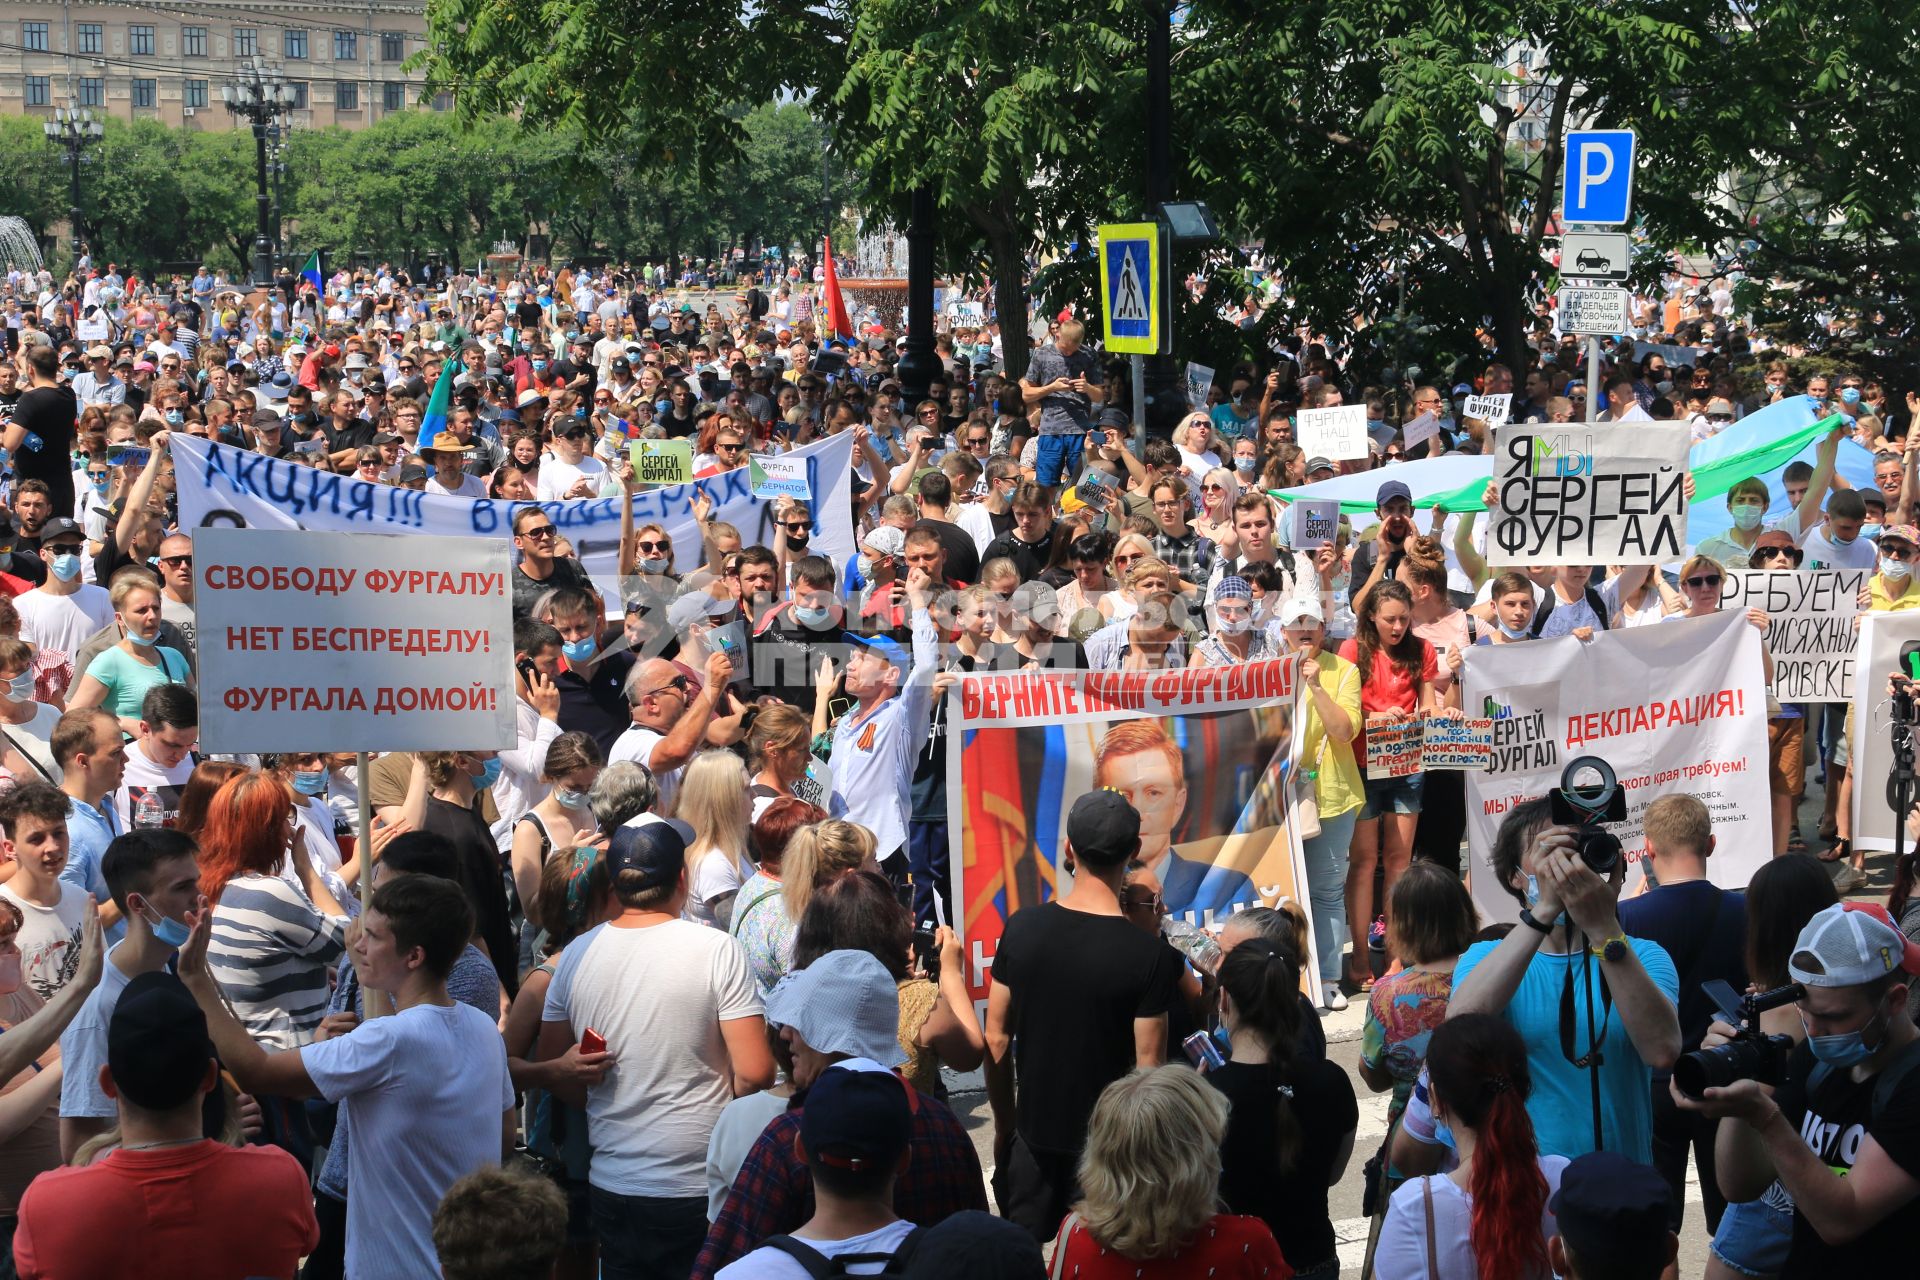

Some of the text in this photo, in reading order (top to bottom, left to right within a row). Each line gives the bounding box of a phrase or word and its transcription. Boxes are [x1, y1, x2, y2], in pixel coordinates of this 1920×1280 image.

[1578, 142, 1614, 208] P
[1569, 291, 1618, 300] ТОЛЬКО ДЛЯ
[1567, 301, 1619, 311] ВЛАДЕЛЬЦЕВ
[1563, 311, 1622, 321] ПАРКОВОЧНЫХ
[1566, 321, 1618, 331] РАЗРЕШЕНИЙ
[1304, 410, 1358, 427] ФУРГАЛ
[1470, 403, 1503, 417] ФУРГАЛ
[1320, 424, 1349, 439] НАШ
[641, 453, 679, 469] СЕРГЕЙ
[761, 462, 794, 473] ФУРГАЛ
[643, 468, 683, 482] ФУРГАЛ
[751, 480, 807, 493] ГУБЕРНАТОР
[1501, 466, 1684, 516] СЕРГЕЙ
[1306, 518, 1333, 530] СЕРГЕЙ
[1305, 529, 1334, 539] ФУРГАЛ
[1497, 514, 1680, 557] ФУРГАЛ
[204, 564, 504, 596] СВОБОДУ ФУРГАЛУ!
[1719, 571, 1863, 613] РЕБУЕМ
[227, 627, 284, 651] НЕТ
[292, 627, 490, 656] БЕСПРЕДЕЛУ!
[1775, 659, 1854, 699] РОВСКЕ
[962, 657, 1293, 720] ВЕРНИТЕ НАМ ФУРГАЛА!
[223, 681, 497, 715] ФУРГАЛА ДОМОЙ!
[1494, 708, 1546, 747] ЕРГЕЙ
[1566, 689, 1744, 749] ДЕКЛАРАЦИЯ!
[1653, 768, 1680, 787] края
[1682, 756, 1748, 781] требуем!
[1484, 796, 1508, 815] МЫ
